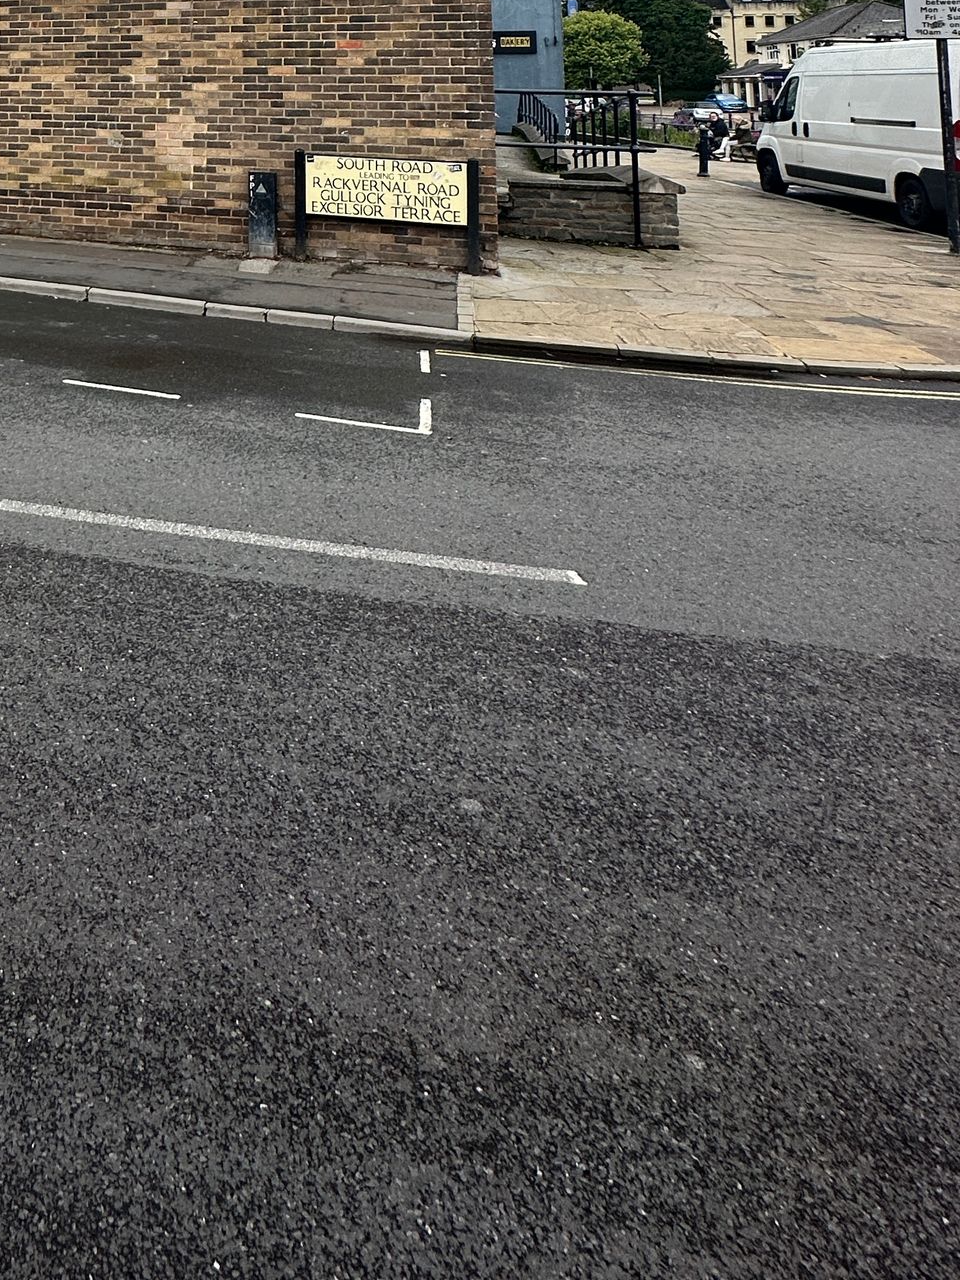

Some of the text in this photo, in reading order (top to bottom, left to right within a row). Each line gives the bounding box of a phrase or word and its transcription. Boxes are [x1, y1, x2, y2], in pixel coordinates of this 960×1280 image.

[501, 38, 529, 46] BAKERY
[336, 157, 385, 171] SOUTH
[391, 160, 433, 173] ROAD
[359, 171, 394, 180] LEADING
[398, 173, 409, 181] TO
[312, 176, 460, 197] RACKVERNAL ROAD
[320, 189, 451, 209] GULLOCK TYNING
[311, 201, 461, 223] EXCELSIOR TERRACE
